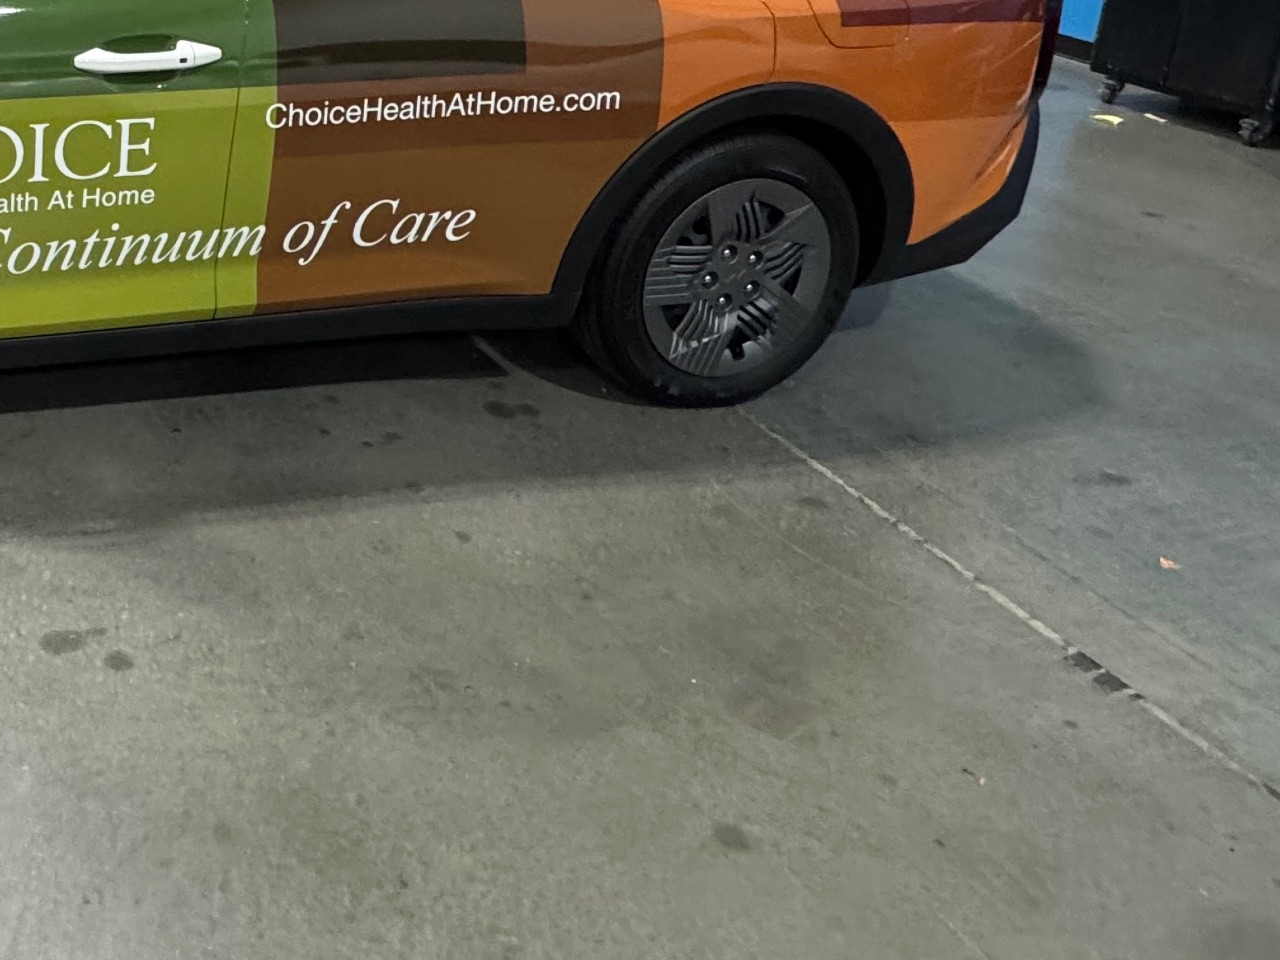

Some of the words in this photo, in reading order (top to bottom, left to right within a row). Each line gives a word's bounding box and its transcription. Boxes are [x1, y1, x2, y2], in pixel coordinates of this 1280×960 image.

[265, 91, 621, 130] ChoiceHealthAtHome.com
[47, 189, 74, 211] At
[81, 187, 156, 209] Home
[282, 200, 352, 266] of
[352, 198, 477, 248] Care
